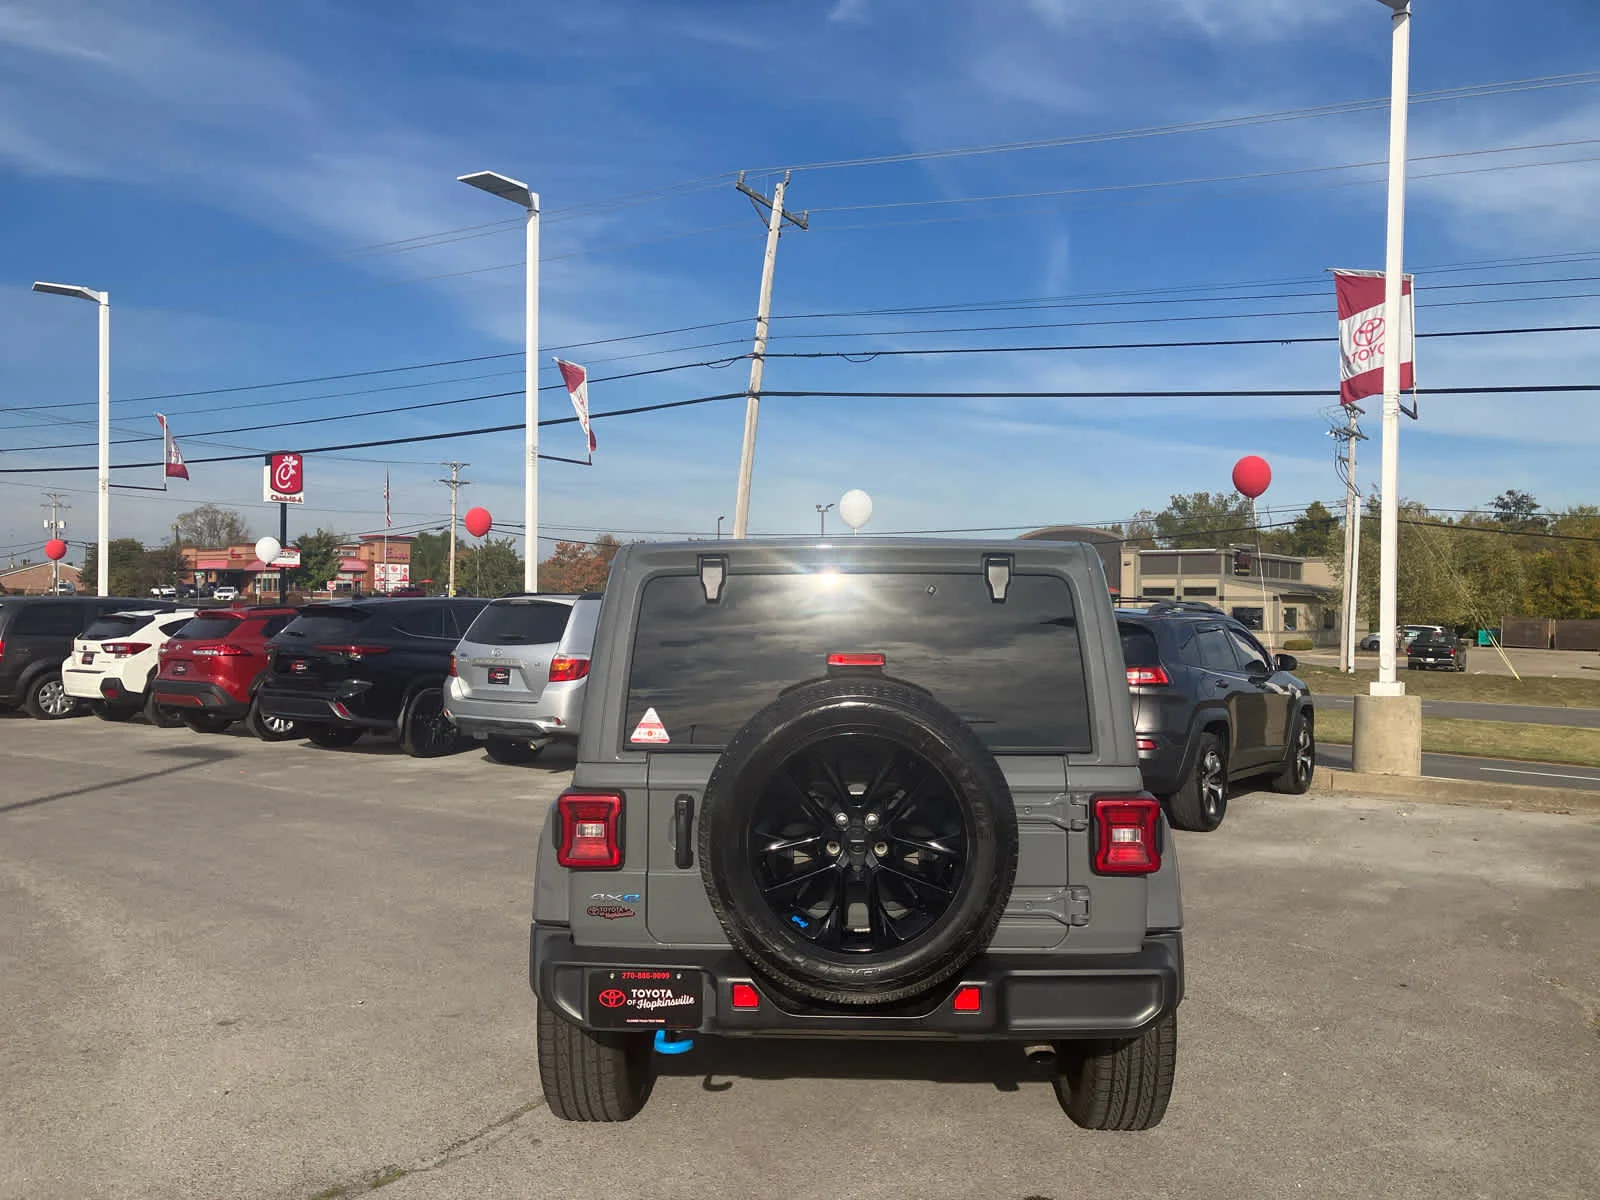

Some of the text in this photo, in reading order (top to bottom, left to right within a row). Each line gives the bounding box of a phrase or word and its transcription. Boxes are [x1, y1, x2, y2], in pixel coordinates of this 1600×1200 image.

[1351, 342, 1384, 363] TOYO
[631, 988, 673, 998] TOYOTA
[626, 994, 695, 1011] OF Hopkinsville
